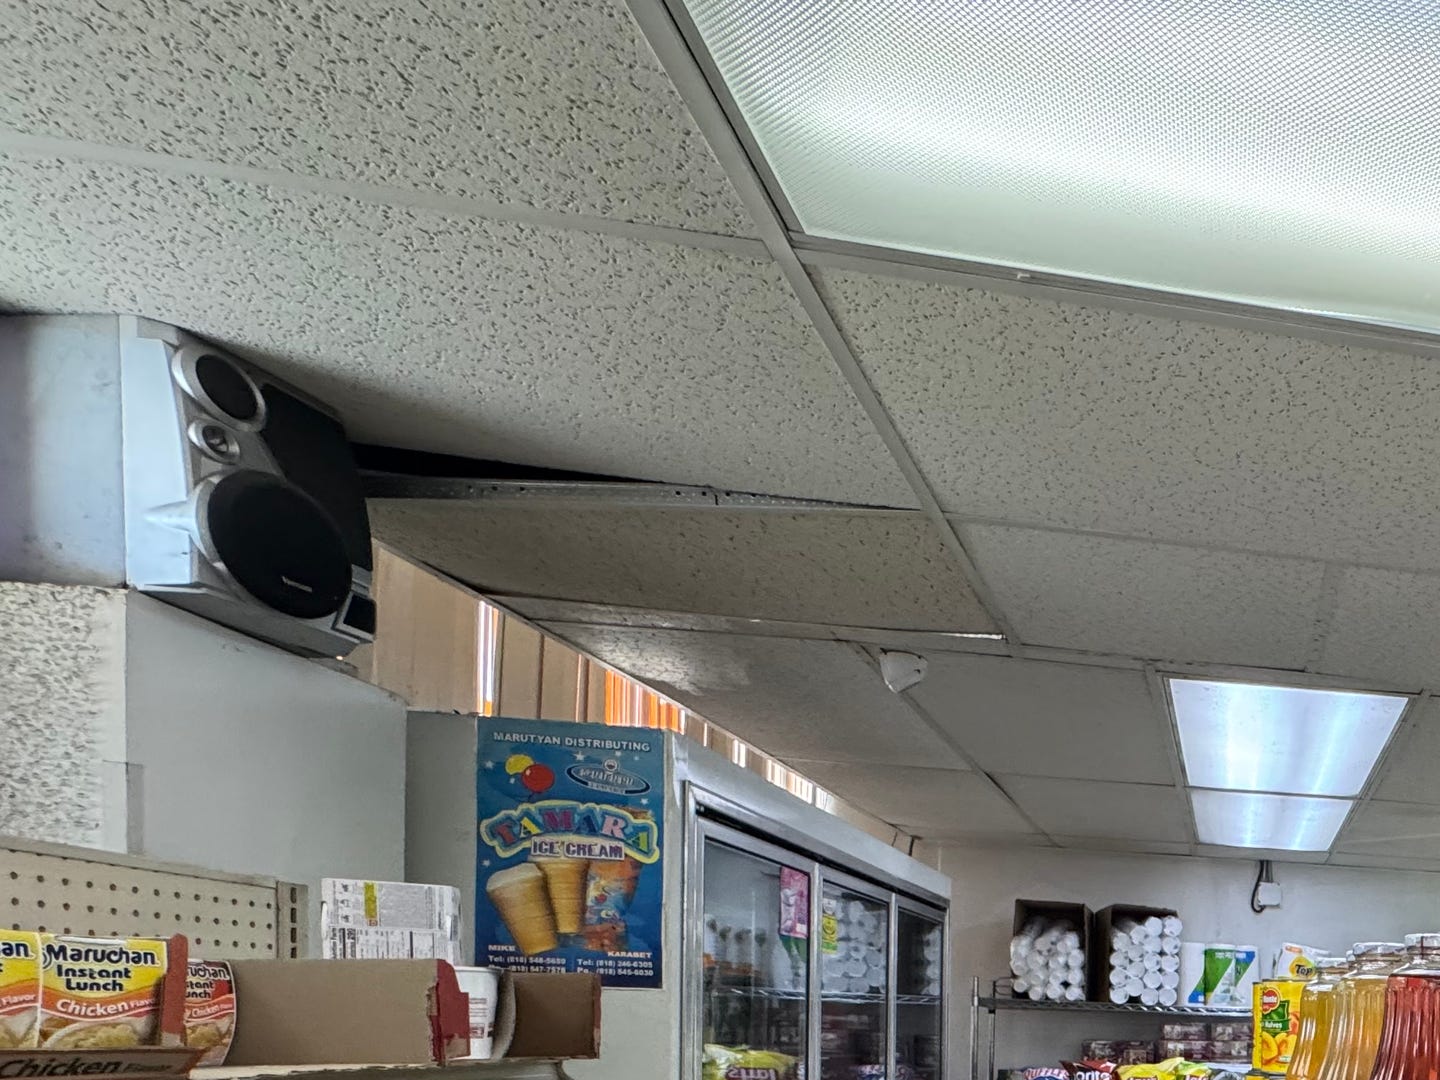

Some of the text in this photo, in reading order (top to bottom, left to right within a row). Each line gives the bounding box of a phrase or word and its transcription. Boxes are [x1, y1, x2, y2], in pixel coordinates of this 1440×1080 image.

[493, 732, 651, 752] MARUTYAN DISTRIBUTING
[494, 806, 650, 852] TAMARA
[533, 840, 623, 859] ICE CREAM
[49, 944, 156, 966] Maruchan
[488, 944, 516, 952] MIKE
[608, 951, 653, 959] KARABET
[488, 955, 505, 963] Tel:
[576, 958, 594, 967] Tel:
[57, 965, 131, 979] Instant
[66, 979, 124, 992] Lunch
[56, 999, 129, 1017] Chicken
[0, 1058, 124, 1079] Chicken
